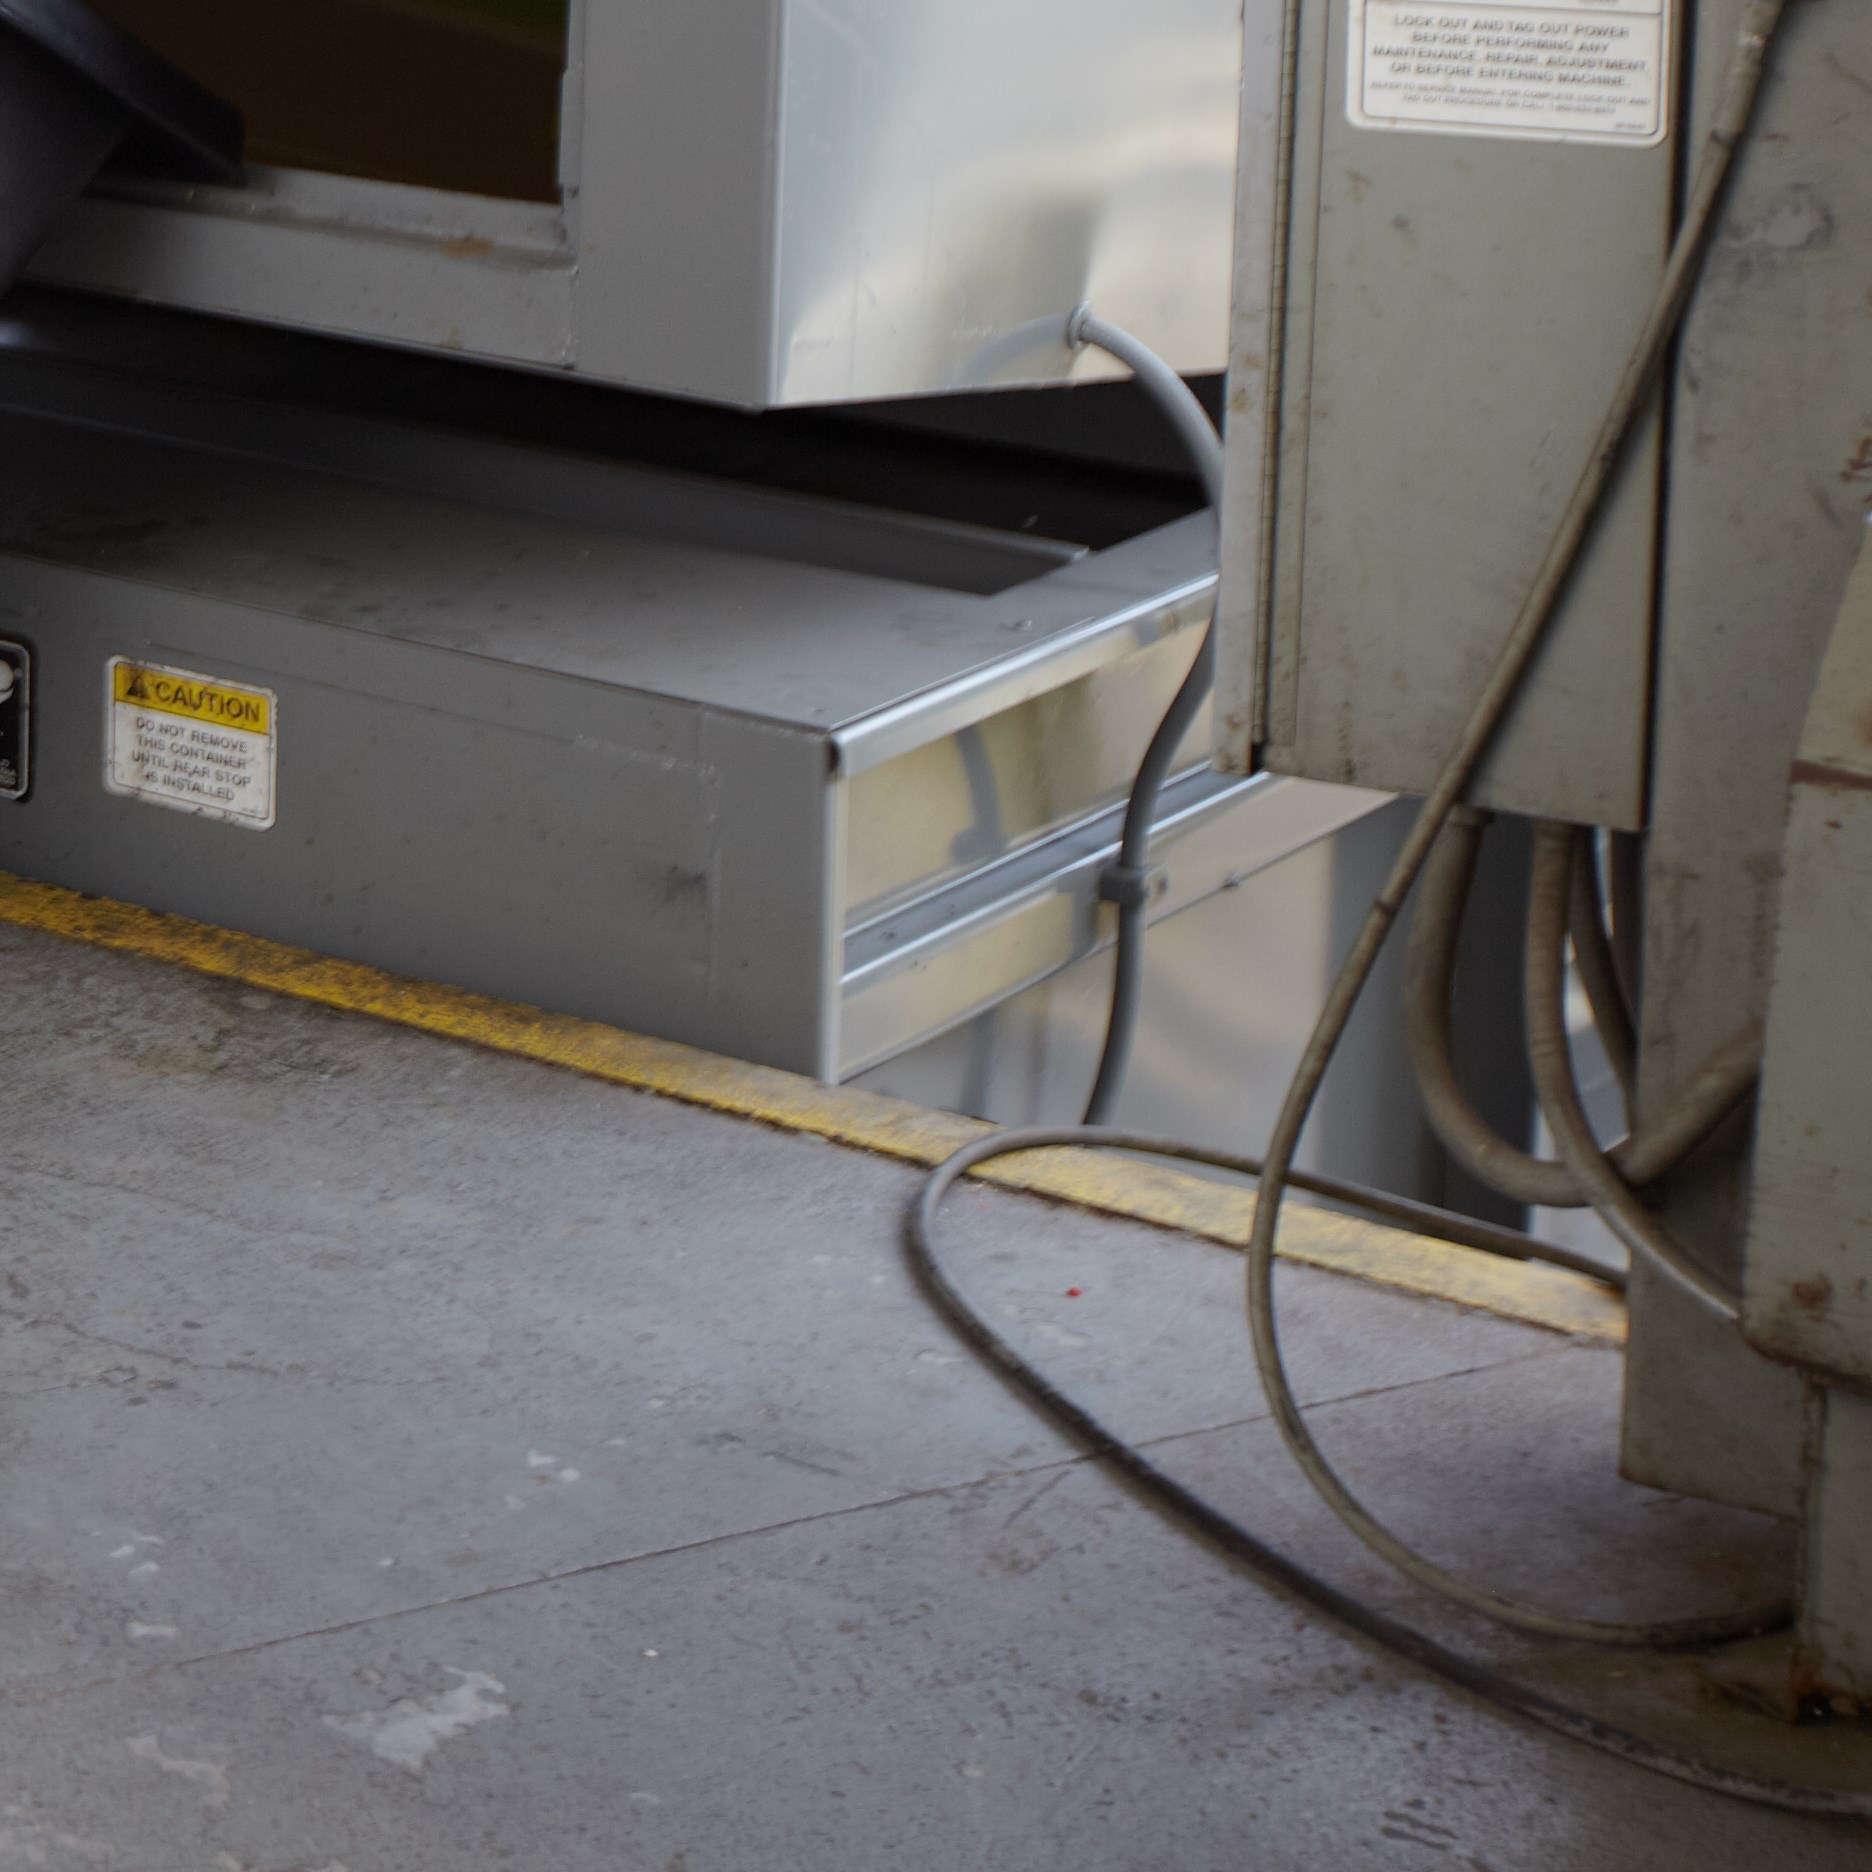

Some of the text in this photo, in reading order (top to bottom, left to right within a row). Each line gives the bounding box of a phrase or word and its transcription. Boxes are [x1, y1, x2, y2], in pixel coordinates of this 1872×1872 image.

[1395, 14, 1630, 38] LOCK OUT AND TAG OUT POWER
[1411, 31, 1610, 53] BEFORE PERFORMING ANY
[1391, 61, 1411, 74] OR
[1415, 63, 1474, 78] BEFORE
[1478, 67, 1554, 82] ENTERING
[155, 681, 260, 722] CAUTION
[136, 717, 248, 753] DO NOT REMOVE
[137, 734, 248, 769] THIS CONTAINER
[132, 750, 252, 787] UNTIL REAR STOP
[163, 774, 235, 801] INSTALLED
